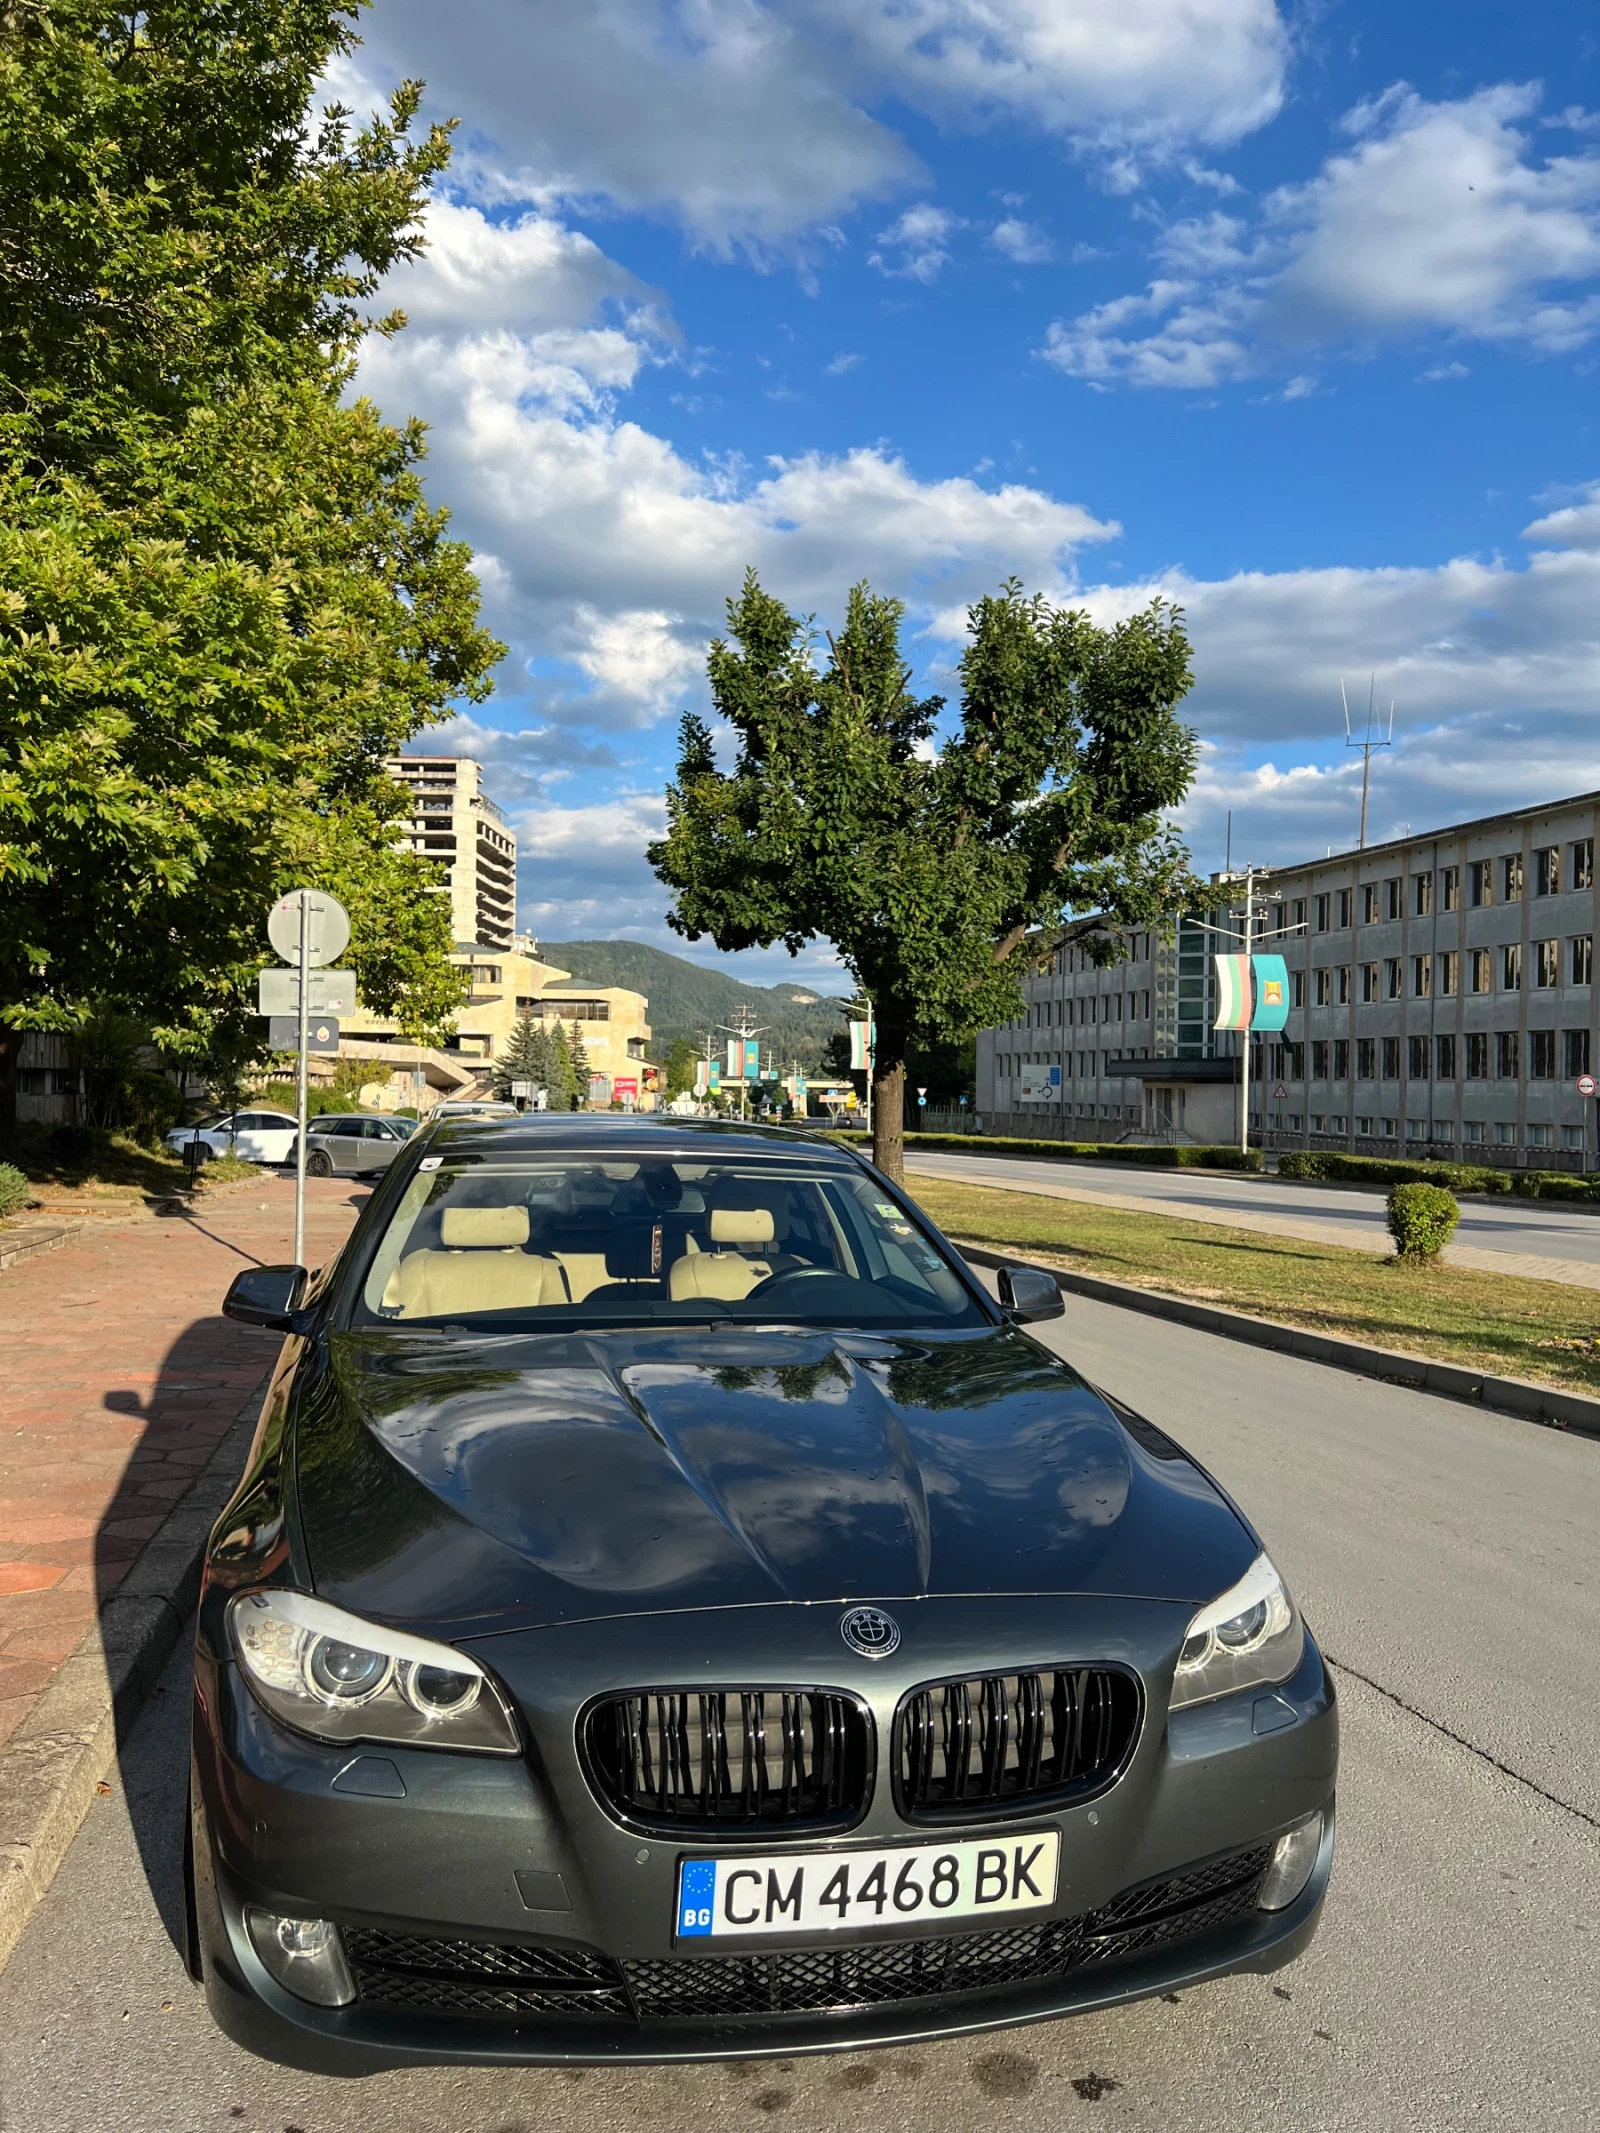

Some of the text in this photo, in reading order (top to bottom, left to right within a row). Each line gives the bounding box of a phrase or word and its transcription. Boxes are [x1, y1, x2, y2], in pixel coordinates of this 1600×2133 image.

[851, 1614, 887, 1625] BMW
[724, 1843, 1045, 1924] CM 4468 BK
[684, 1908, 711, 1926] BG
